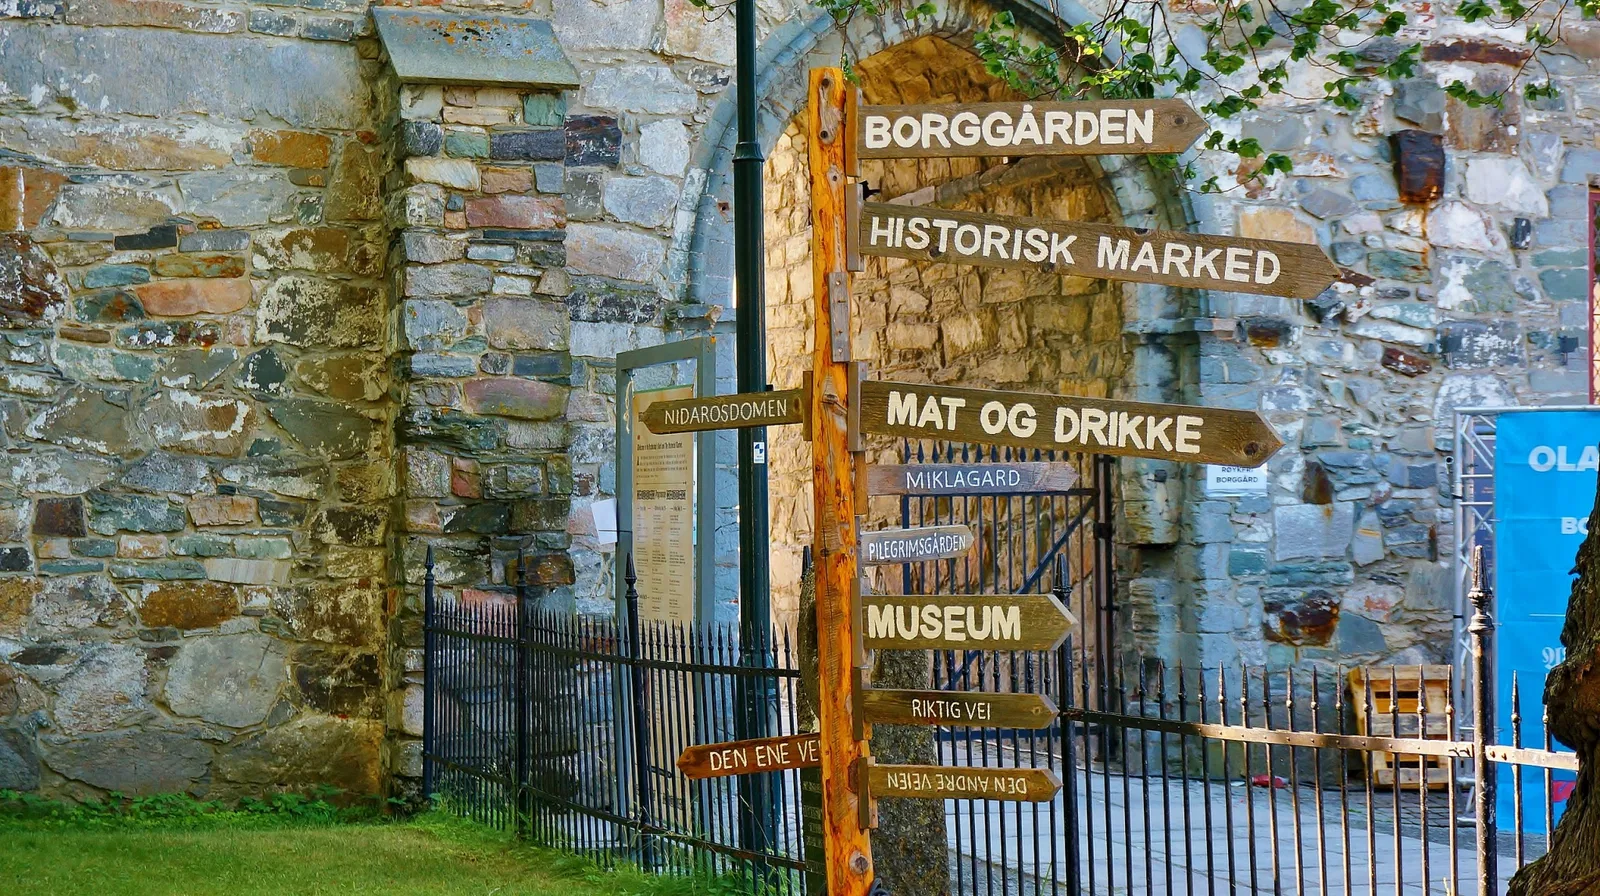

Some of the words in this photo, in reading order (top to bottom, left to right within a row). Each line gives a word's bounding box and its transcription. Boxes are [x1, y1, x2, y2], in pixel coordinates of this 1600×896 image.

[865, 104, 1154, 149] BORGGÅRDEN
[870, 216, 1078, 265] HISTORISK
[1097, 236, 1281, 285] MARKED
[664, 399, 787, 425] NIDAROSDOMEN
[887, 391, 966, 431] MAT
[979, 401, 1037, 438] OG
[1054, 407, 1204, 454] DRIKKE
[906, 469, 1021, 489] MIKLAGARD
[1216, 475, 1258, 483] BORGGÅRD
[869, 532, 966, 561] PILEGRIMSGÅRDEN
[867, 604, 1021, 642] MUSEUM
[912, 698, 961, 719] RIKTIG
[965, 702, 991, 720] VEI
[709, 748, 747, 771] DEN
[755, 742, 791, 767] ENE
[887, 772, 932, 790] VEIEN
[935, 773, 988, 793] ANDRE
[994, 777, 1027, 794] DEN
